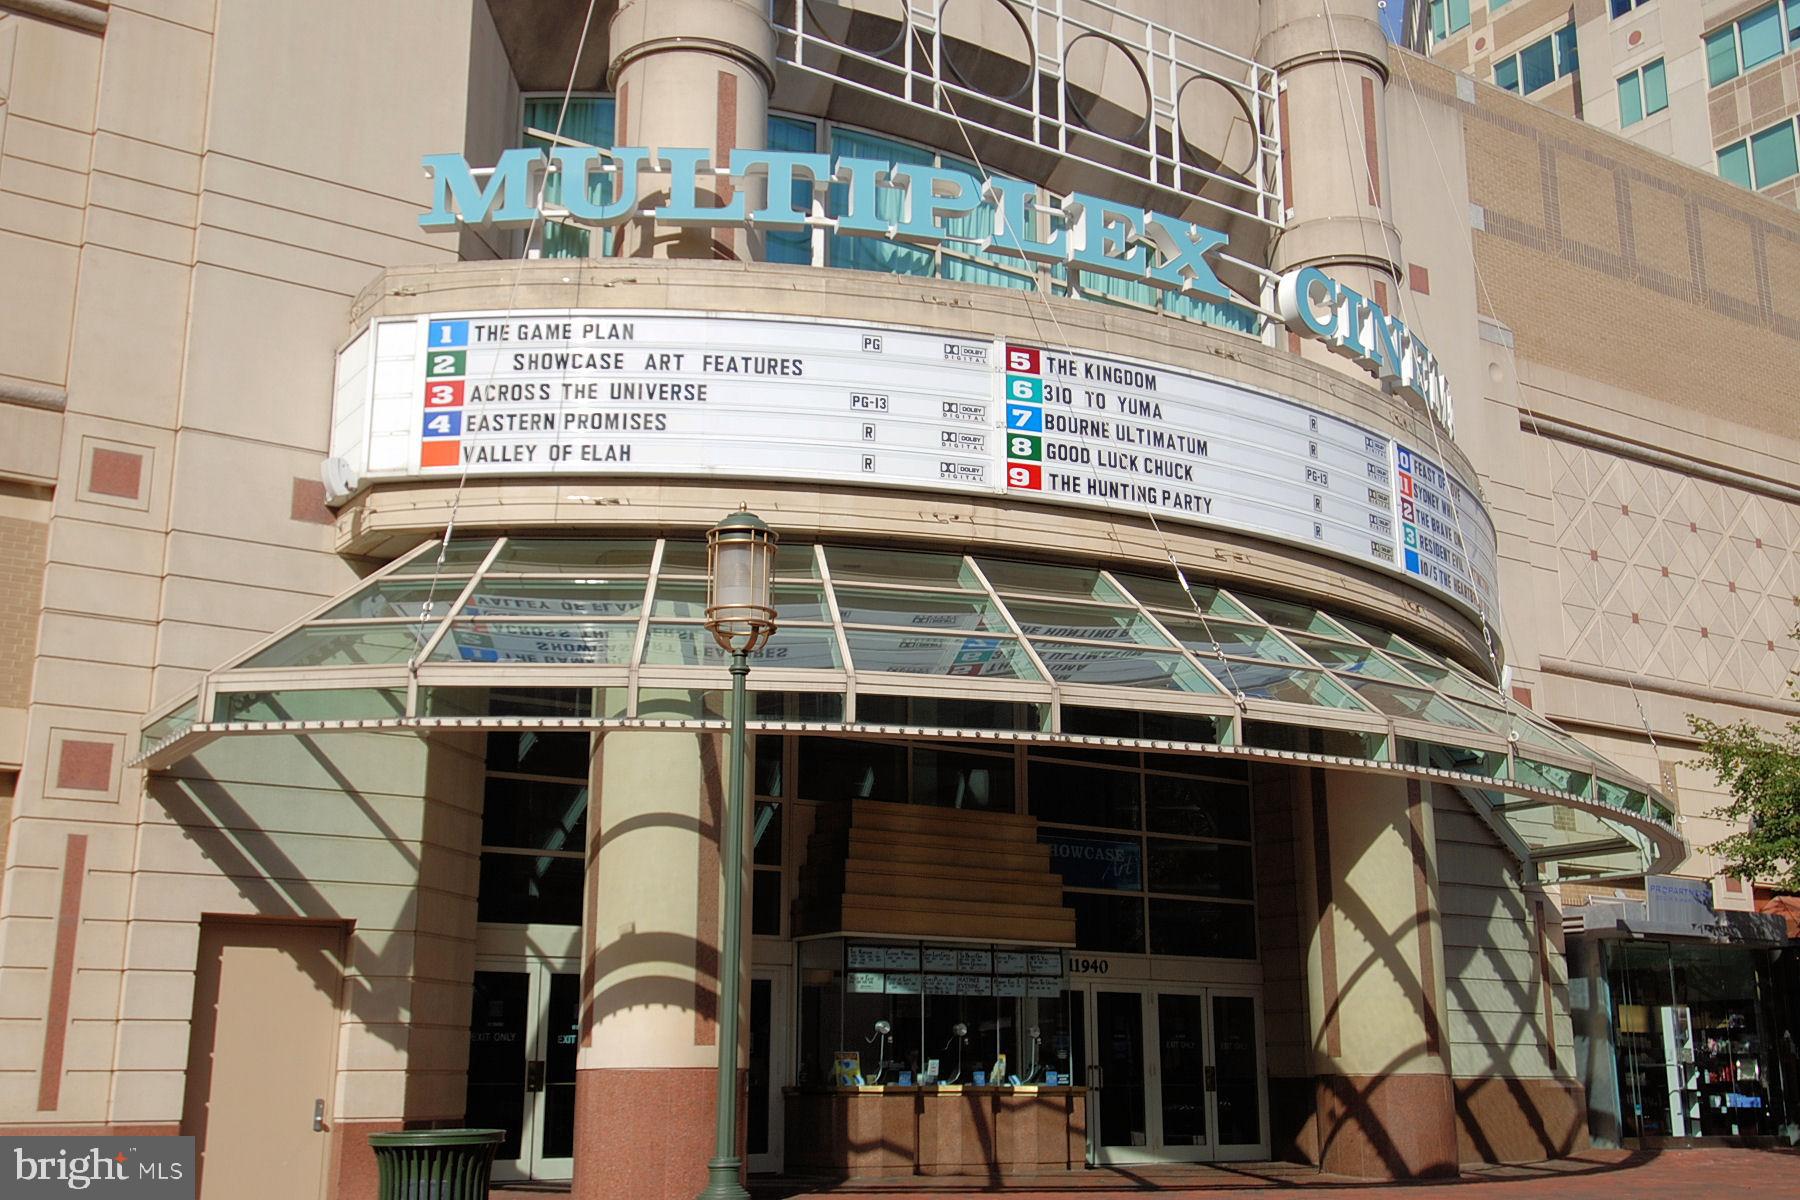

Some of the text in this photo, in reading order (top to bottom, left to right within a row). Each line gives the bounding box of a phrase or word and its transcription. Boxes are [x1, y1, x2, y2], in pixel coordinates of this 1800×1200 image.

[418, 146, 1231, 301] MULTIPLEX
[440, 323, 634, 343] 1 THE GAME PLAN
[864, 337, 881, 350] PG
[963, 348, 984, 356] DOLBY
[433, 353, 803, 376] 2 SHOWCASE ART FEATURES
[944, 354, 987, 364] DIGITAL
[1010, 351, 1157, 391] 5 THE KINGDOM
[431, 383, 707, 404] 3 ACROSS THE UNIVERSE
[852, 395, 887, 410] PG-13
[1012, 380, 1033, 399] 6
[1085, 391, 1106, 410] TO
[1118, 396, 1162, 420] YUMA
[943, 412, 986, 422] DIGITAL
[962, 406, 983, 414] DOLBY
[428, 412, 667, 433] 4 EASTERN PROMISES
[865, 426, 873, 438] R
[961, 435, 981, 443] DOLBY
[1012, 409, 1208, 457] 7 BOURNE ULTIMATUM
[463, 444, 631, 463] VALLEY OF ELAH
[941, 442, 984, 451] DIGITAL
[864, 457, 873, 470] R
[1011, 437, 1193, 482] 8 GOOD LUCK CHUCK
[940, 473, 983, 482] DIGITAL
[960, 466, 980, 474] DOLBY
[1307, 469, 1328, 485] PG-13
[1413, 459, 1436, 485] FEAST
[1437, 473, 1446, 489] OF
[1447, 482, 1461, 502] OVE
[1009, 467, 1212, 514] 9 THE HUNTING PARTY
[1413, 484, 1440, 510] SYDNEY
[1416, 509, 1430, 528] THE
[1431, 517, 1452, 543] BRAVE
[1453, 532, 1465, 552] ON
[1419, 535, 1450, 567] RESIDENT
[1452, 553, 1464, 573] EVIL
[1420, 559, 1439, 582] 10/5
[1439, 569, 1452, 589] THE
[1051, 843, 1124, 862] HOWCASE
[1069, 958, 1109, 974] 11940
[558, 1035, 576, 1044] EXIT
